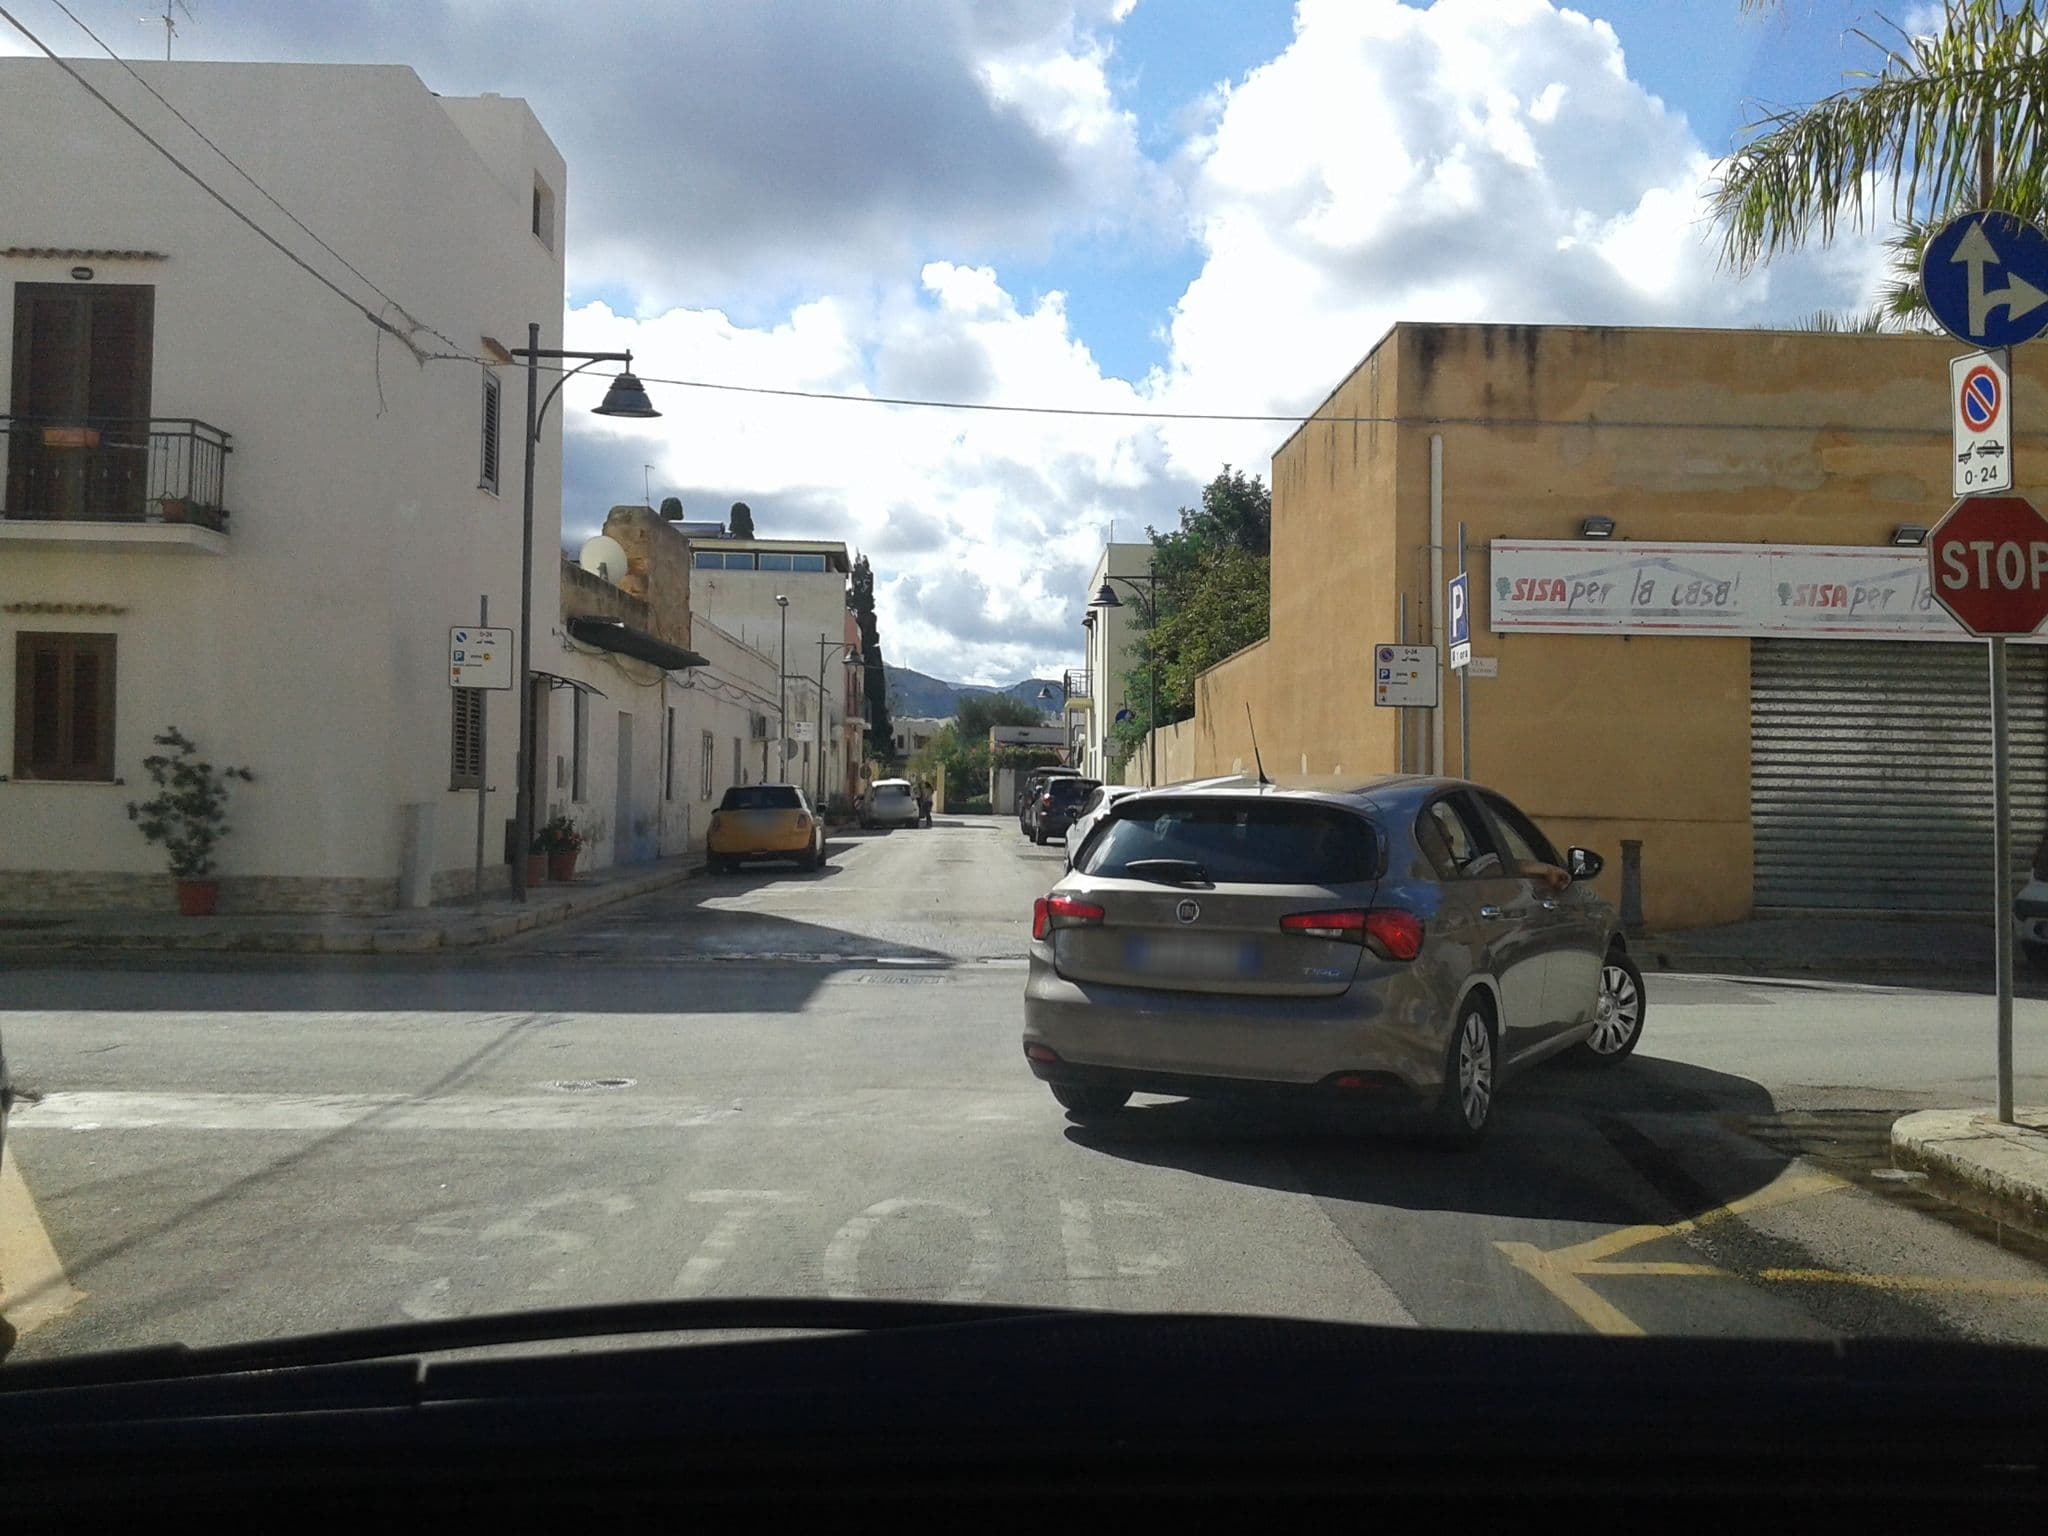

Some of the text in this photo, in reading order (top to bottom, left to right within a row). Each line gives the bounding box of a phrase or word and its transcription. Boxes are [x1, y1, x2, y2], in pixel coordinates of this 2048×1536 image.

[1964, 464, 1998, 486] 0-24
[1941, 540, 2048, 590] STOP
[1453, 584, 1464, 637] P
[1511, 577, 1567, 602] SISA
[1568, 580, 1617, 611] per
[1630, 568, 1656, 606] la
[1792, 583, 1848, 608] SISA
[1850, 586, 1897, 616] per
